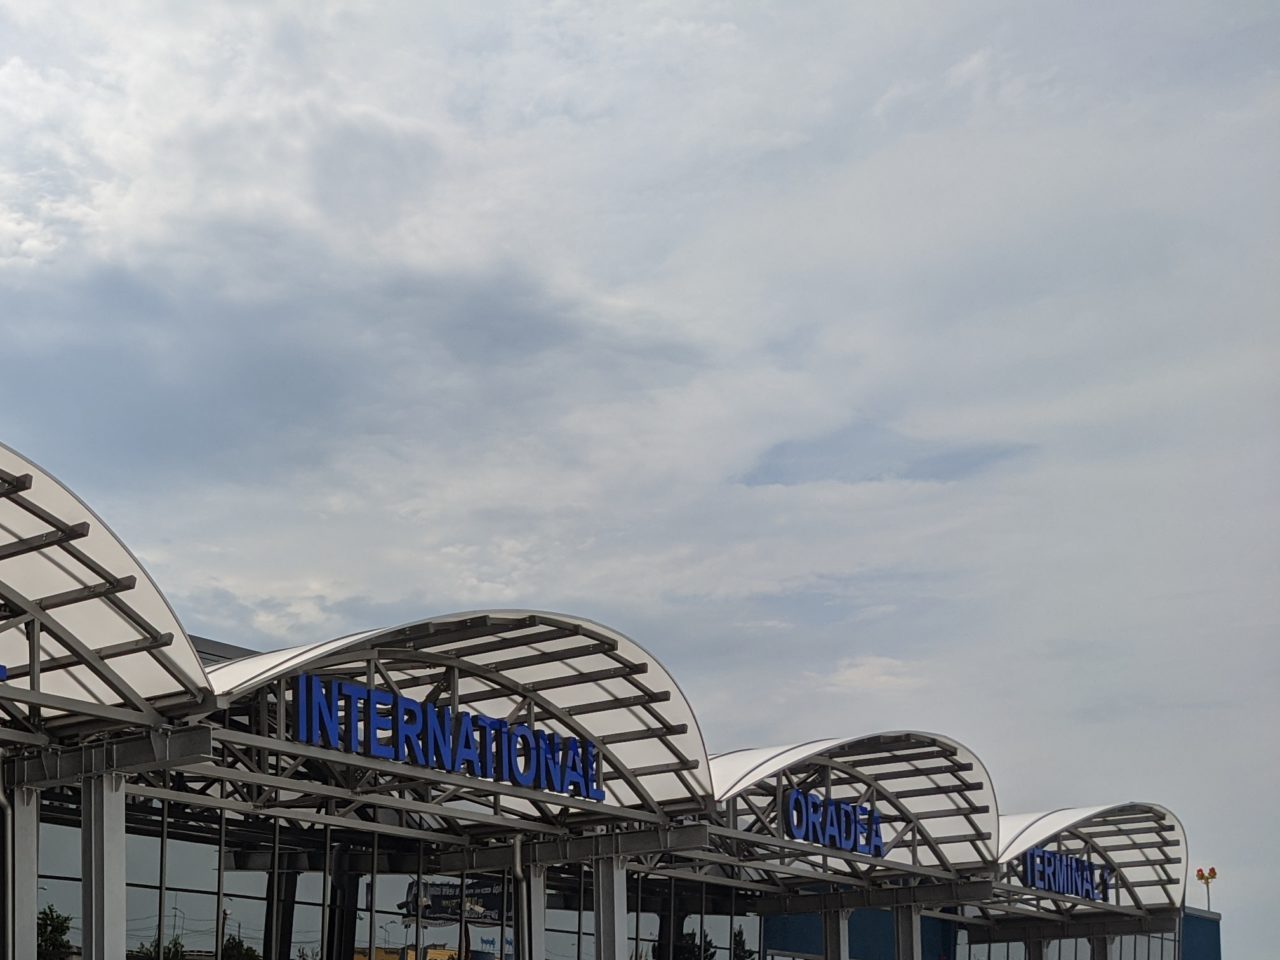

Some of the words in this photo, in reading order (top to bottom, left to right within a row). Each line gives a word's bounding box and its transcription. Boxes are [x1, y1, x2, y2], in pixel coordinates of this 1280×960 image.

[293, 671, 606, 802] INTERNATIONAL
[784, 788, 885, 858] ORADEA
[1023, 847, 1103, 901] TERMINAL
